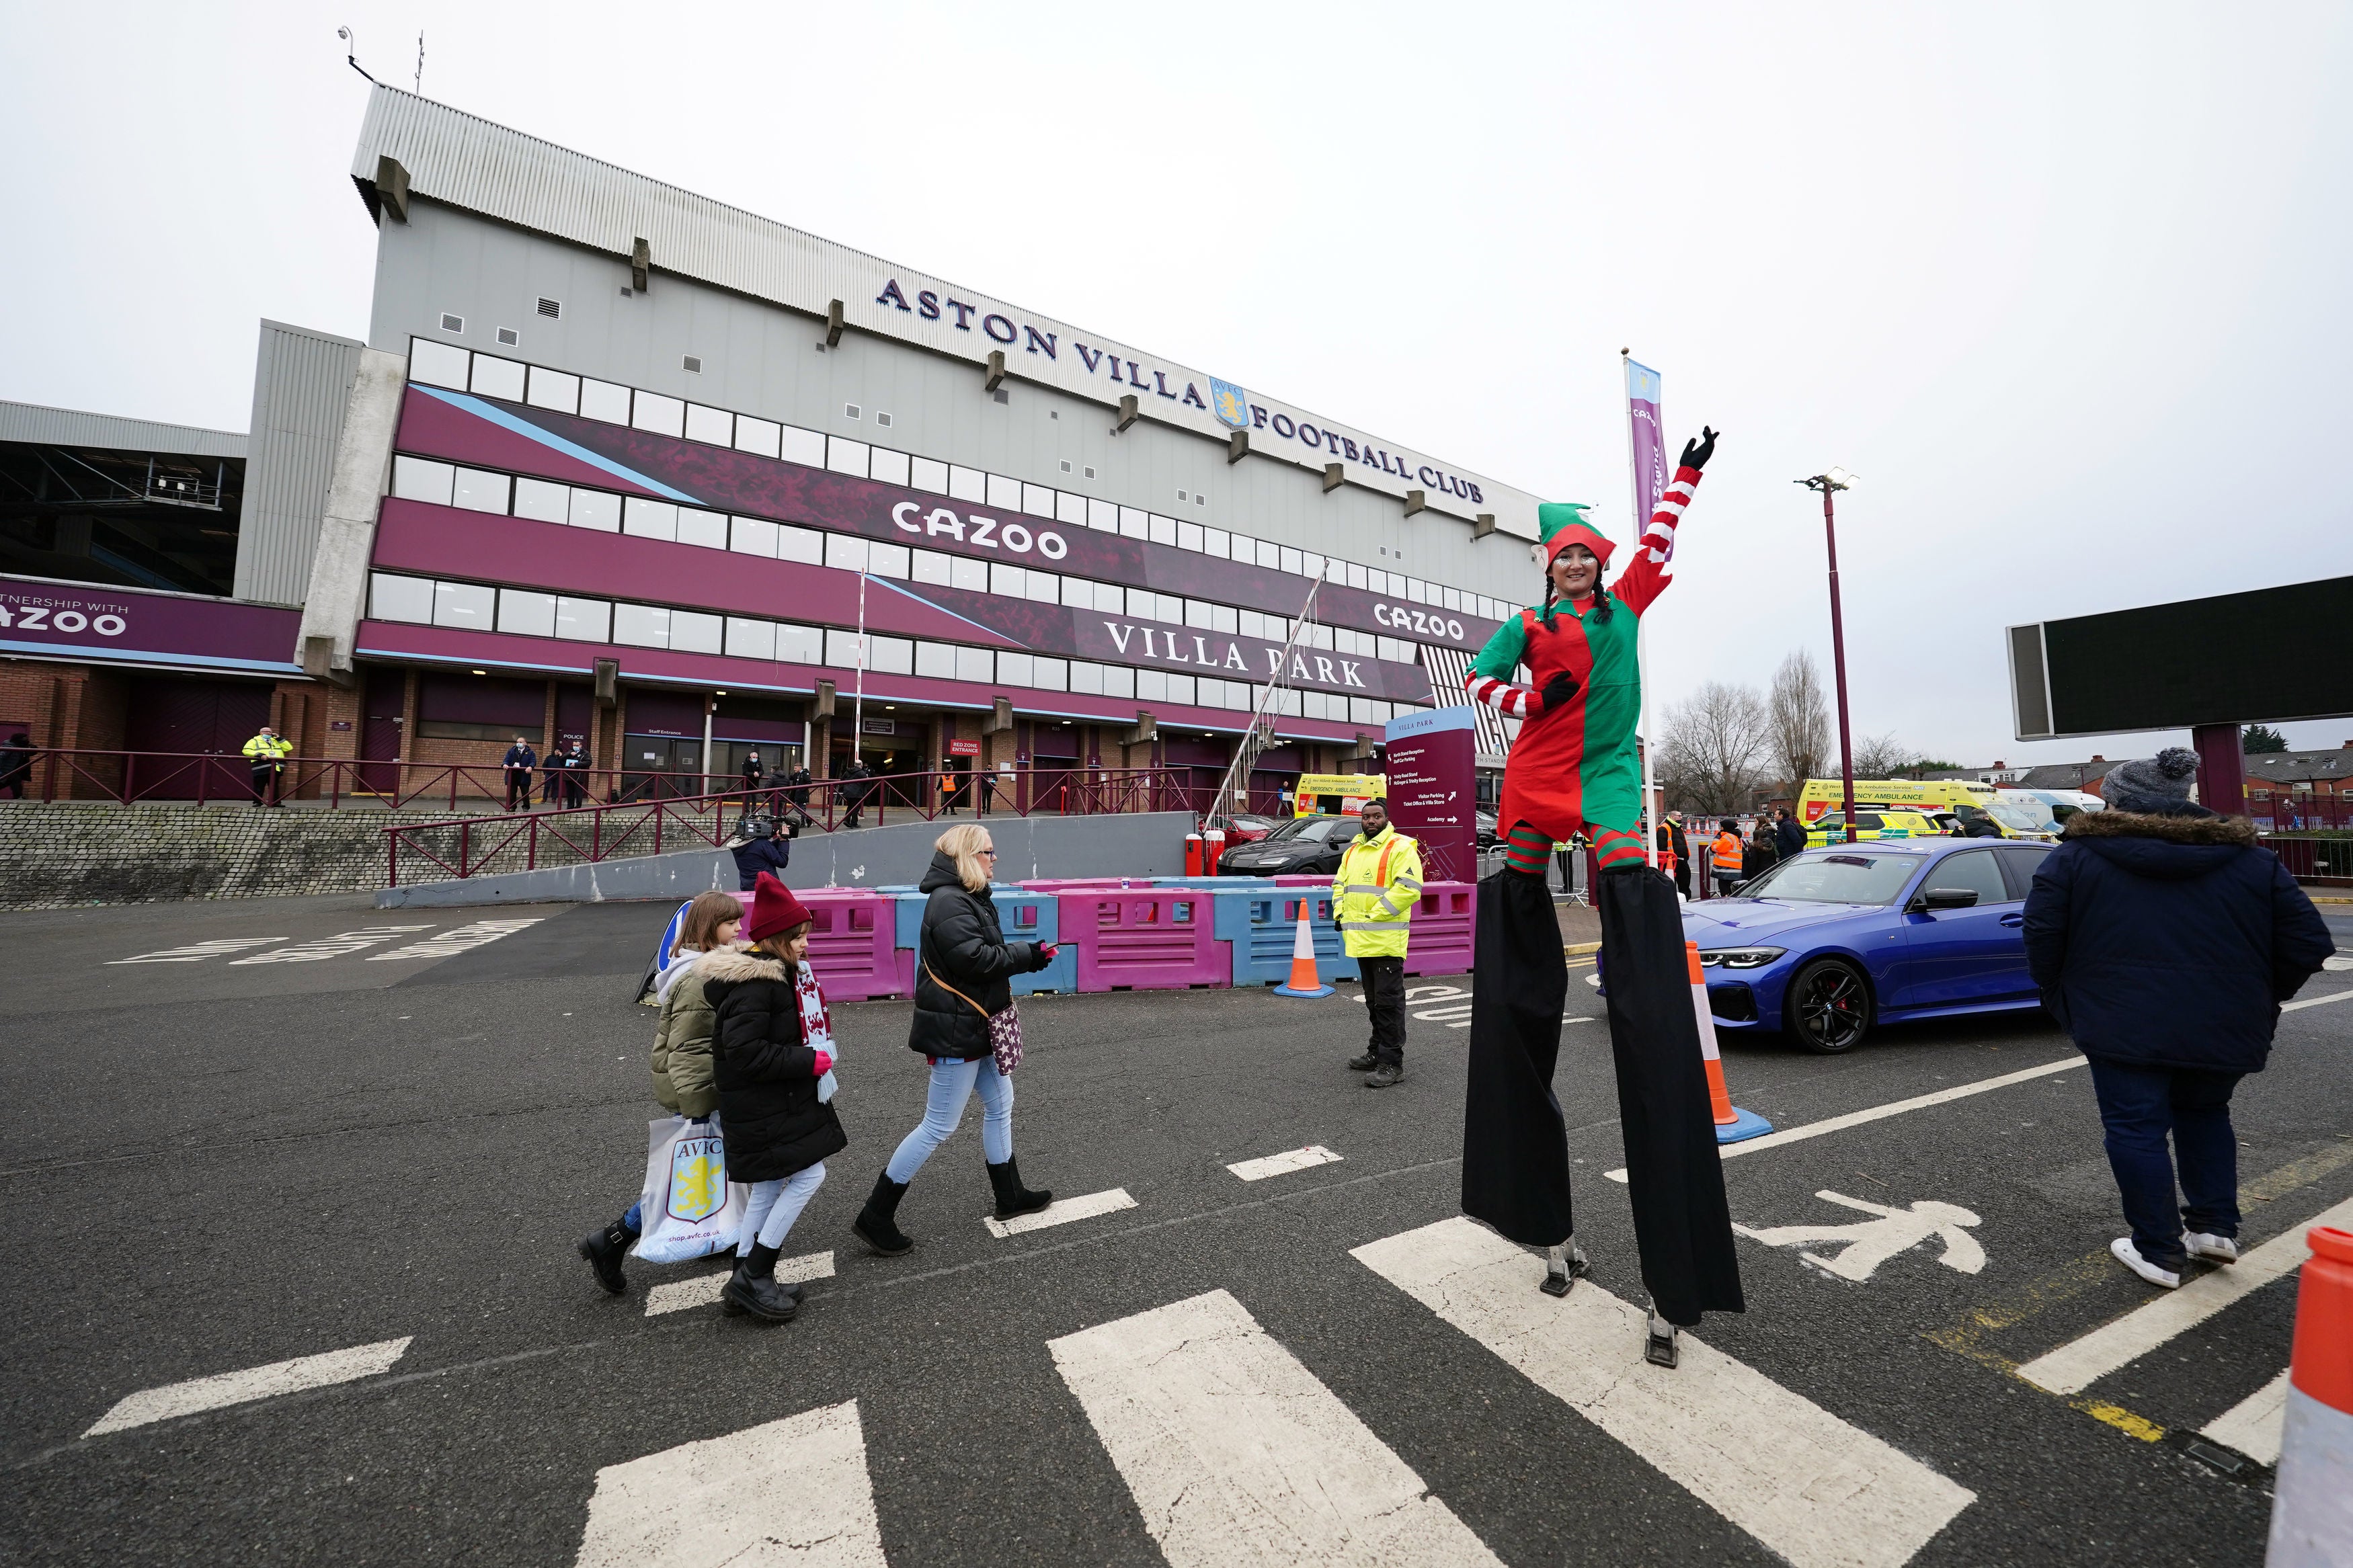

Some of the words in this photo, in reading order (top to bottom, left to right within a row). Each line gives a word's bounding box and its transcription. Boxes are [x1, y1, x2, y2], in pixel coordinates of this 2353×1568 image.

[876, 278, 1058, 361] ASTON
[1074, 342, 1207, 410] VILLA
[1250, 404, 1414, 480] FOOTBALL
[1419, 466, 1484, 504] CLUB
[1213, 380, 1242, 396] AVFC
[891, 501, 1068, 560] CAZOO
[87, 603, 128, 614] WITH
[1373, 603, 1464, 641] CAZOO
[1103, 620, 1249, 672] VILLA
[1265, 647, 1366, 688] PARK
[1417, 718, 1433, 727] PARK
[102, 937, 290, 964] ONLY
[228, 924, 437, 965] PLAYERS
[677, 1140, 722, 1158] AVFC
[668, 1229, 721, 1243] shop.avfc.co.uk
